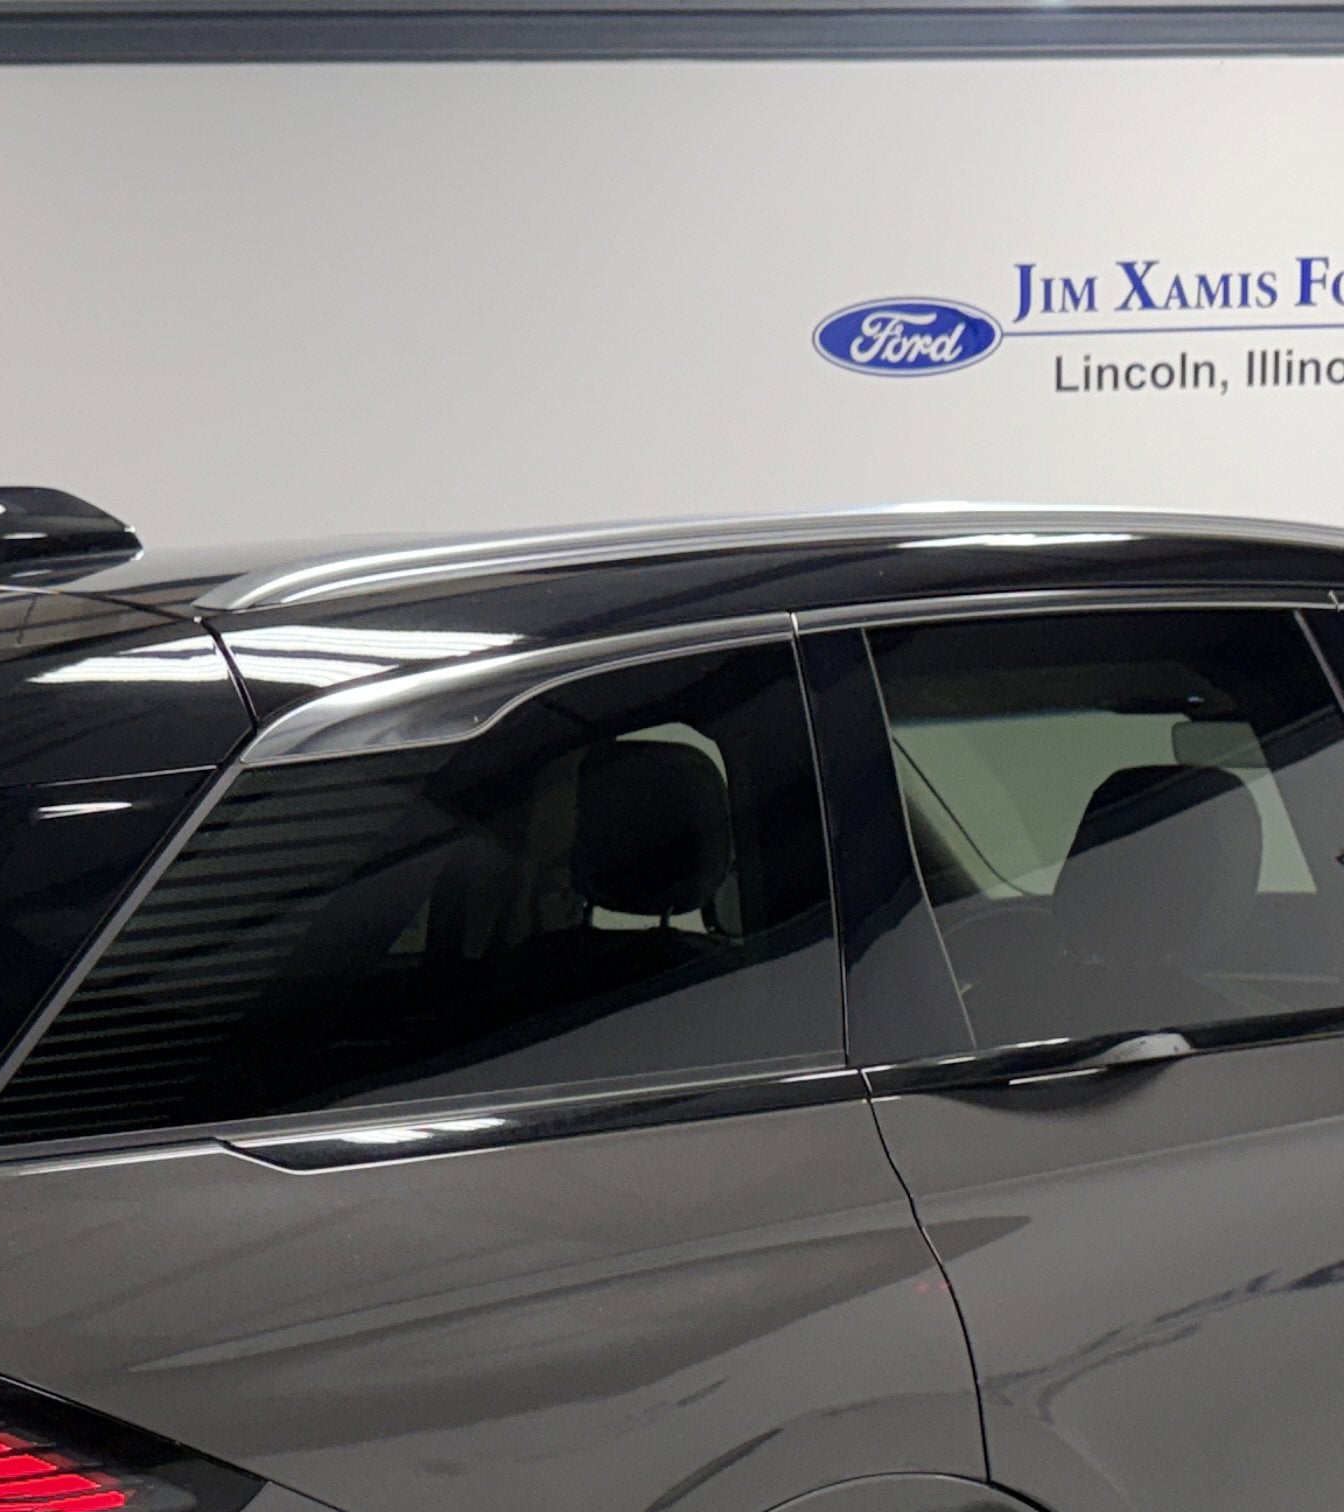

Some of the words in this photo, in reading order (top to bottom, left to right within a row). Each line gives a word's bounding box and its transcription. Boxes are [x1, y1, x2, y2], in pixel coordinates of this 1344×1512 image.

[1013, 263, 1097, 323] JIM
[1115, 260, 1279, 311] XAMIS
[850, 310, 966, 363] Ford
[1055, 353, 1229, 395] Lincoln,
